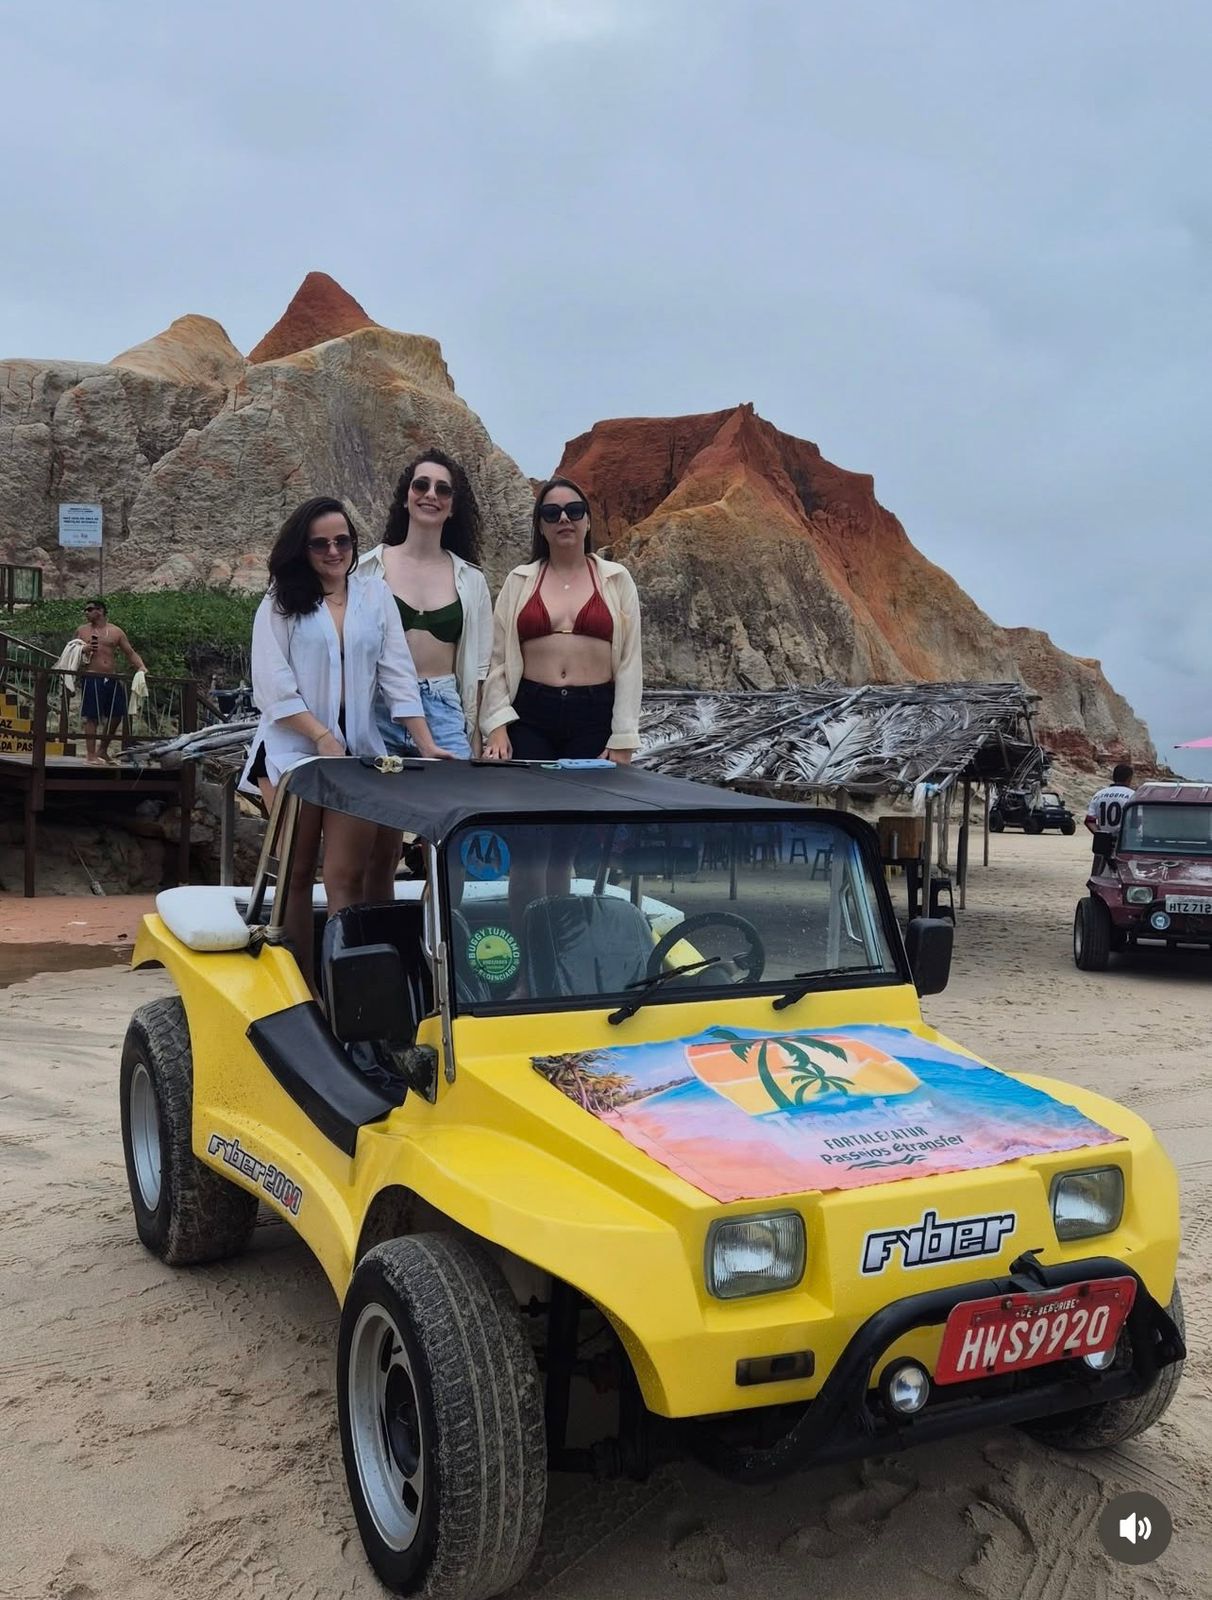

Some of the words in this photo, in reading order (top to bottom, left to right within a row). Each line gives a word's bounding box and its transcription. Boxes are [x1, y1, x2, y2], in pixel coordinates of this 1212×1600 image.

[16, 742, 33, 751] PAS
[1100, 801, 1122, 827] 10
[1169, 902, 1212, 913] HTZ712
[468, 928, 486, 959] BUGGY
[487, 926, 520, 958] TURISMO
[955, 1305, 1110, 1372] HWS9920
